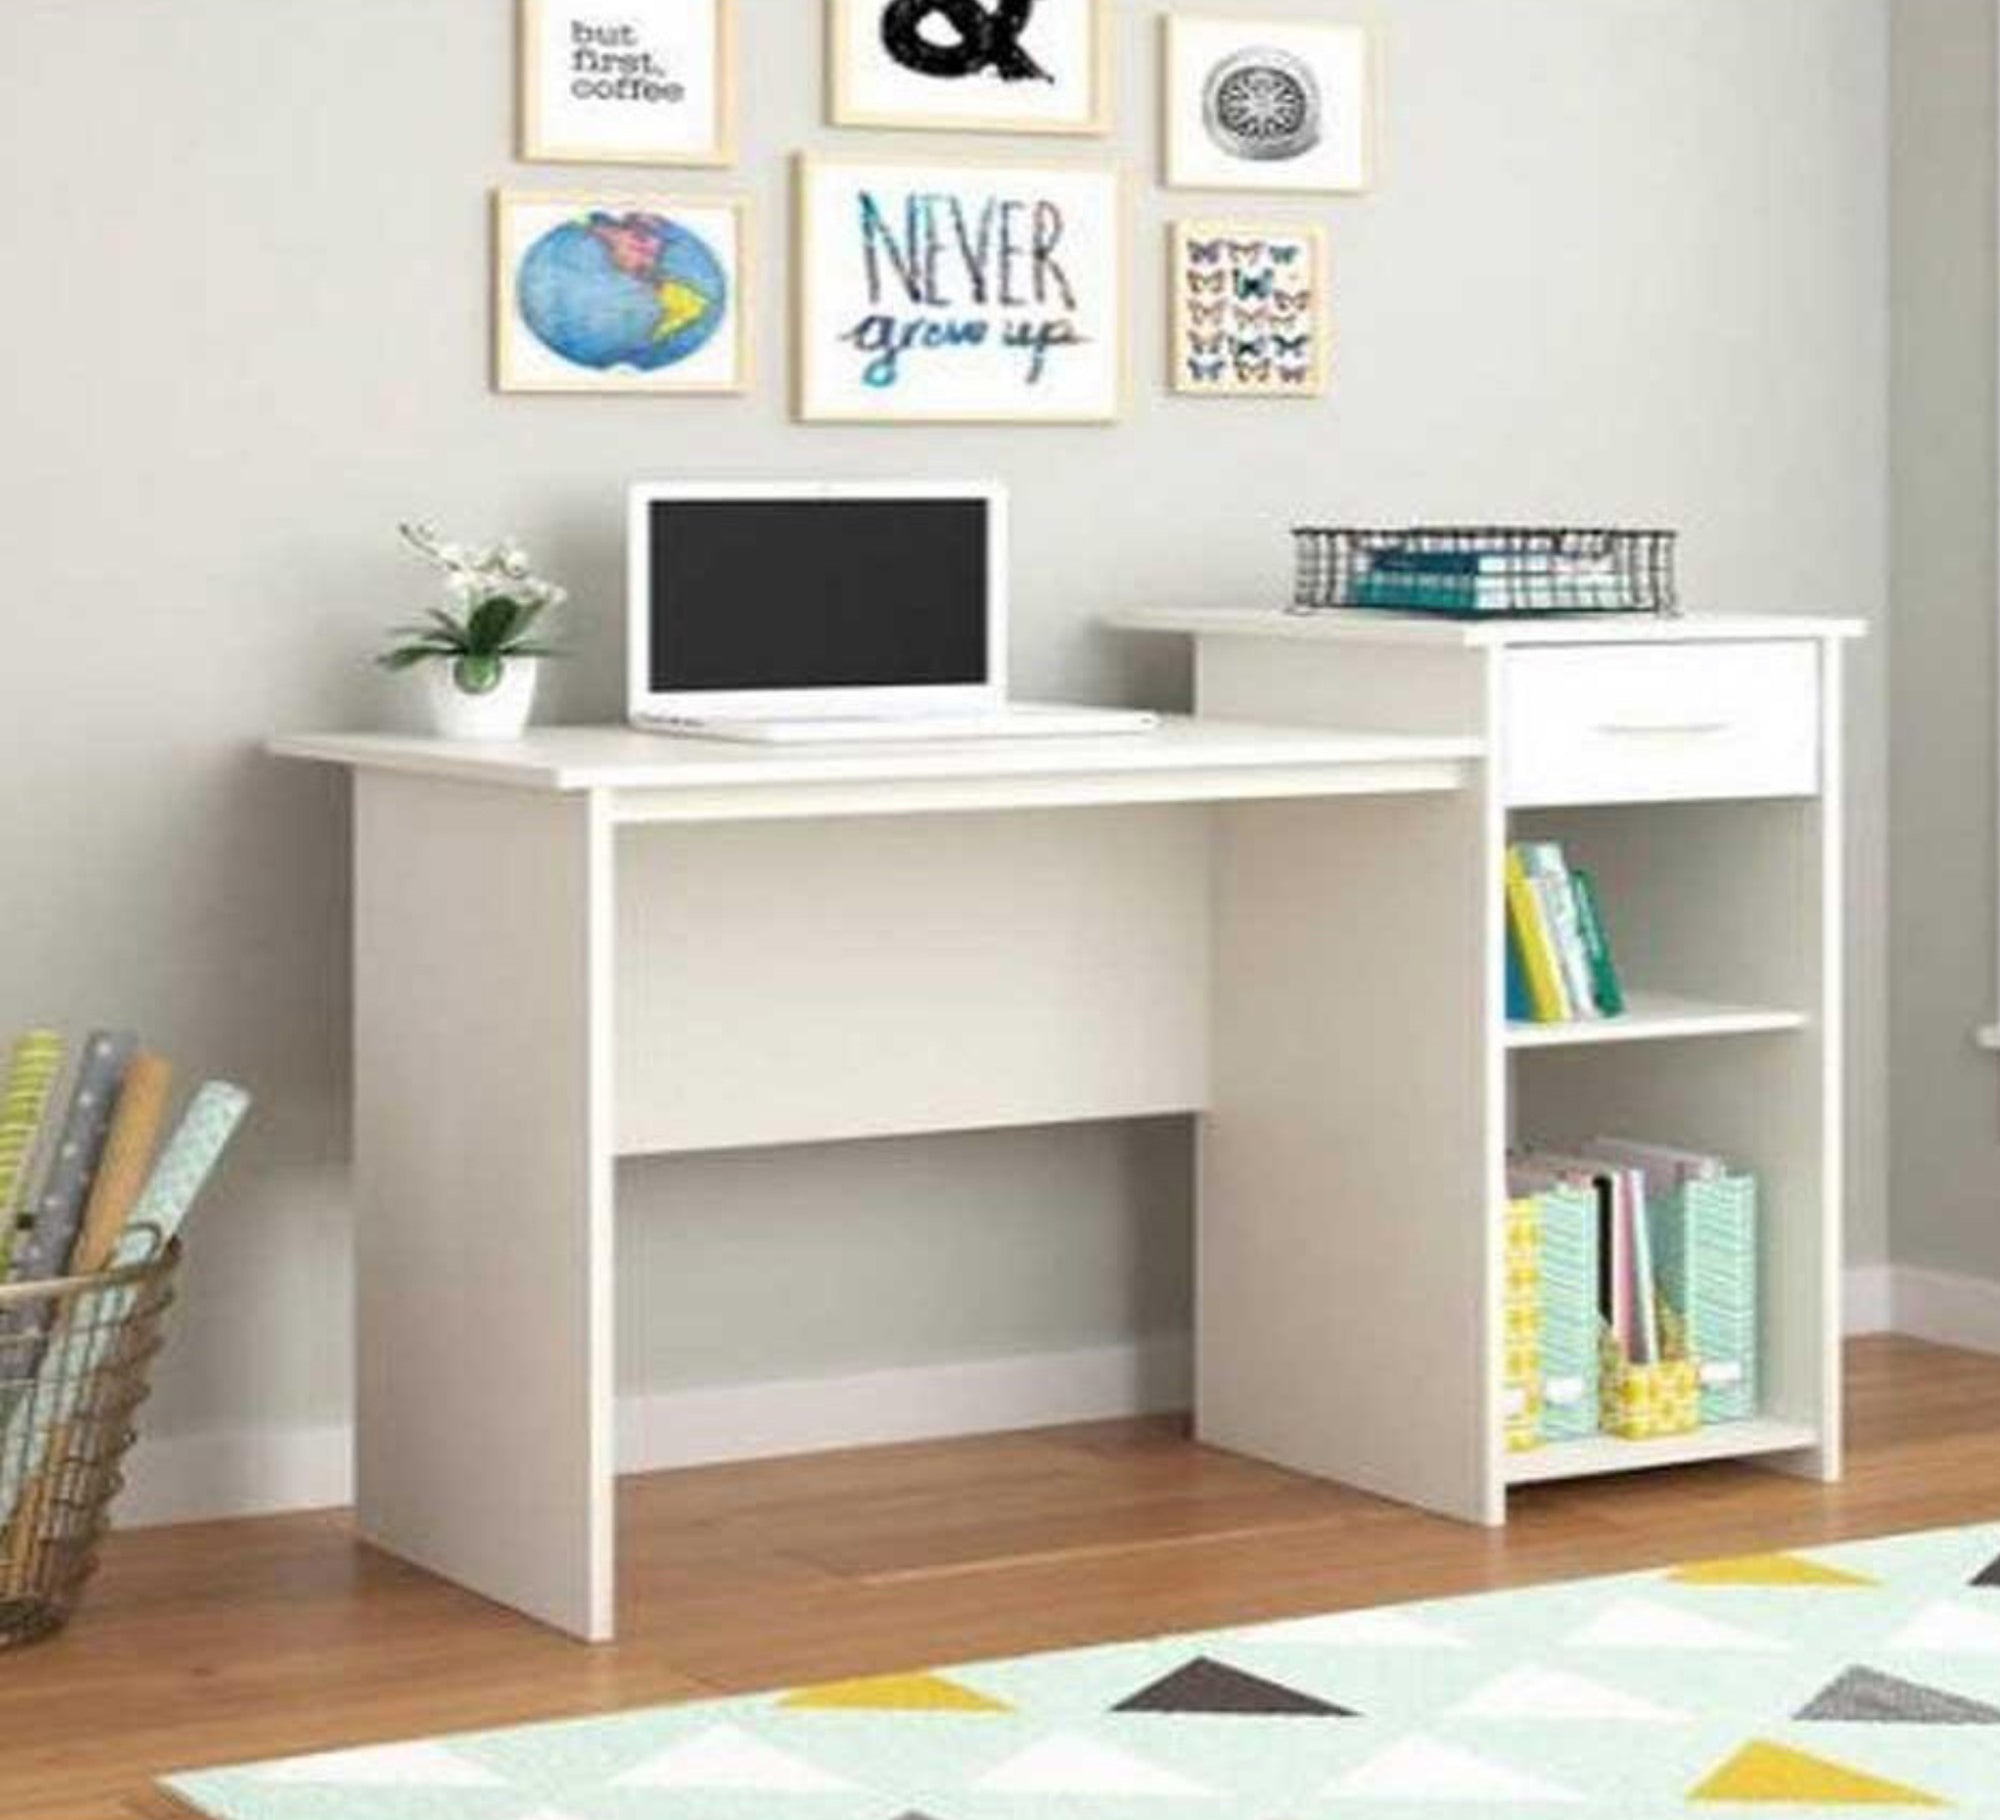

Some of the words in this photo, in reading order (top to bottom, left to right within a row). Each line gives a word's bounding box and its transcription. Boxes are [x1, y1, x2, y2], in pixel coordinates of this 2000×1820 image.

[570, 20, 638, 47] but
[570, 47, 667, 78] first,
[570, 76, 686, 103] coffee
[857, 190, 1077, 311] NEVER
[838, 313, 988, 388] grow
[998, 319, 1090, 386] up
